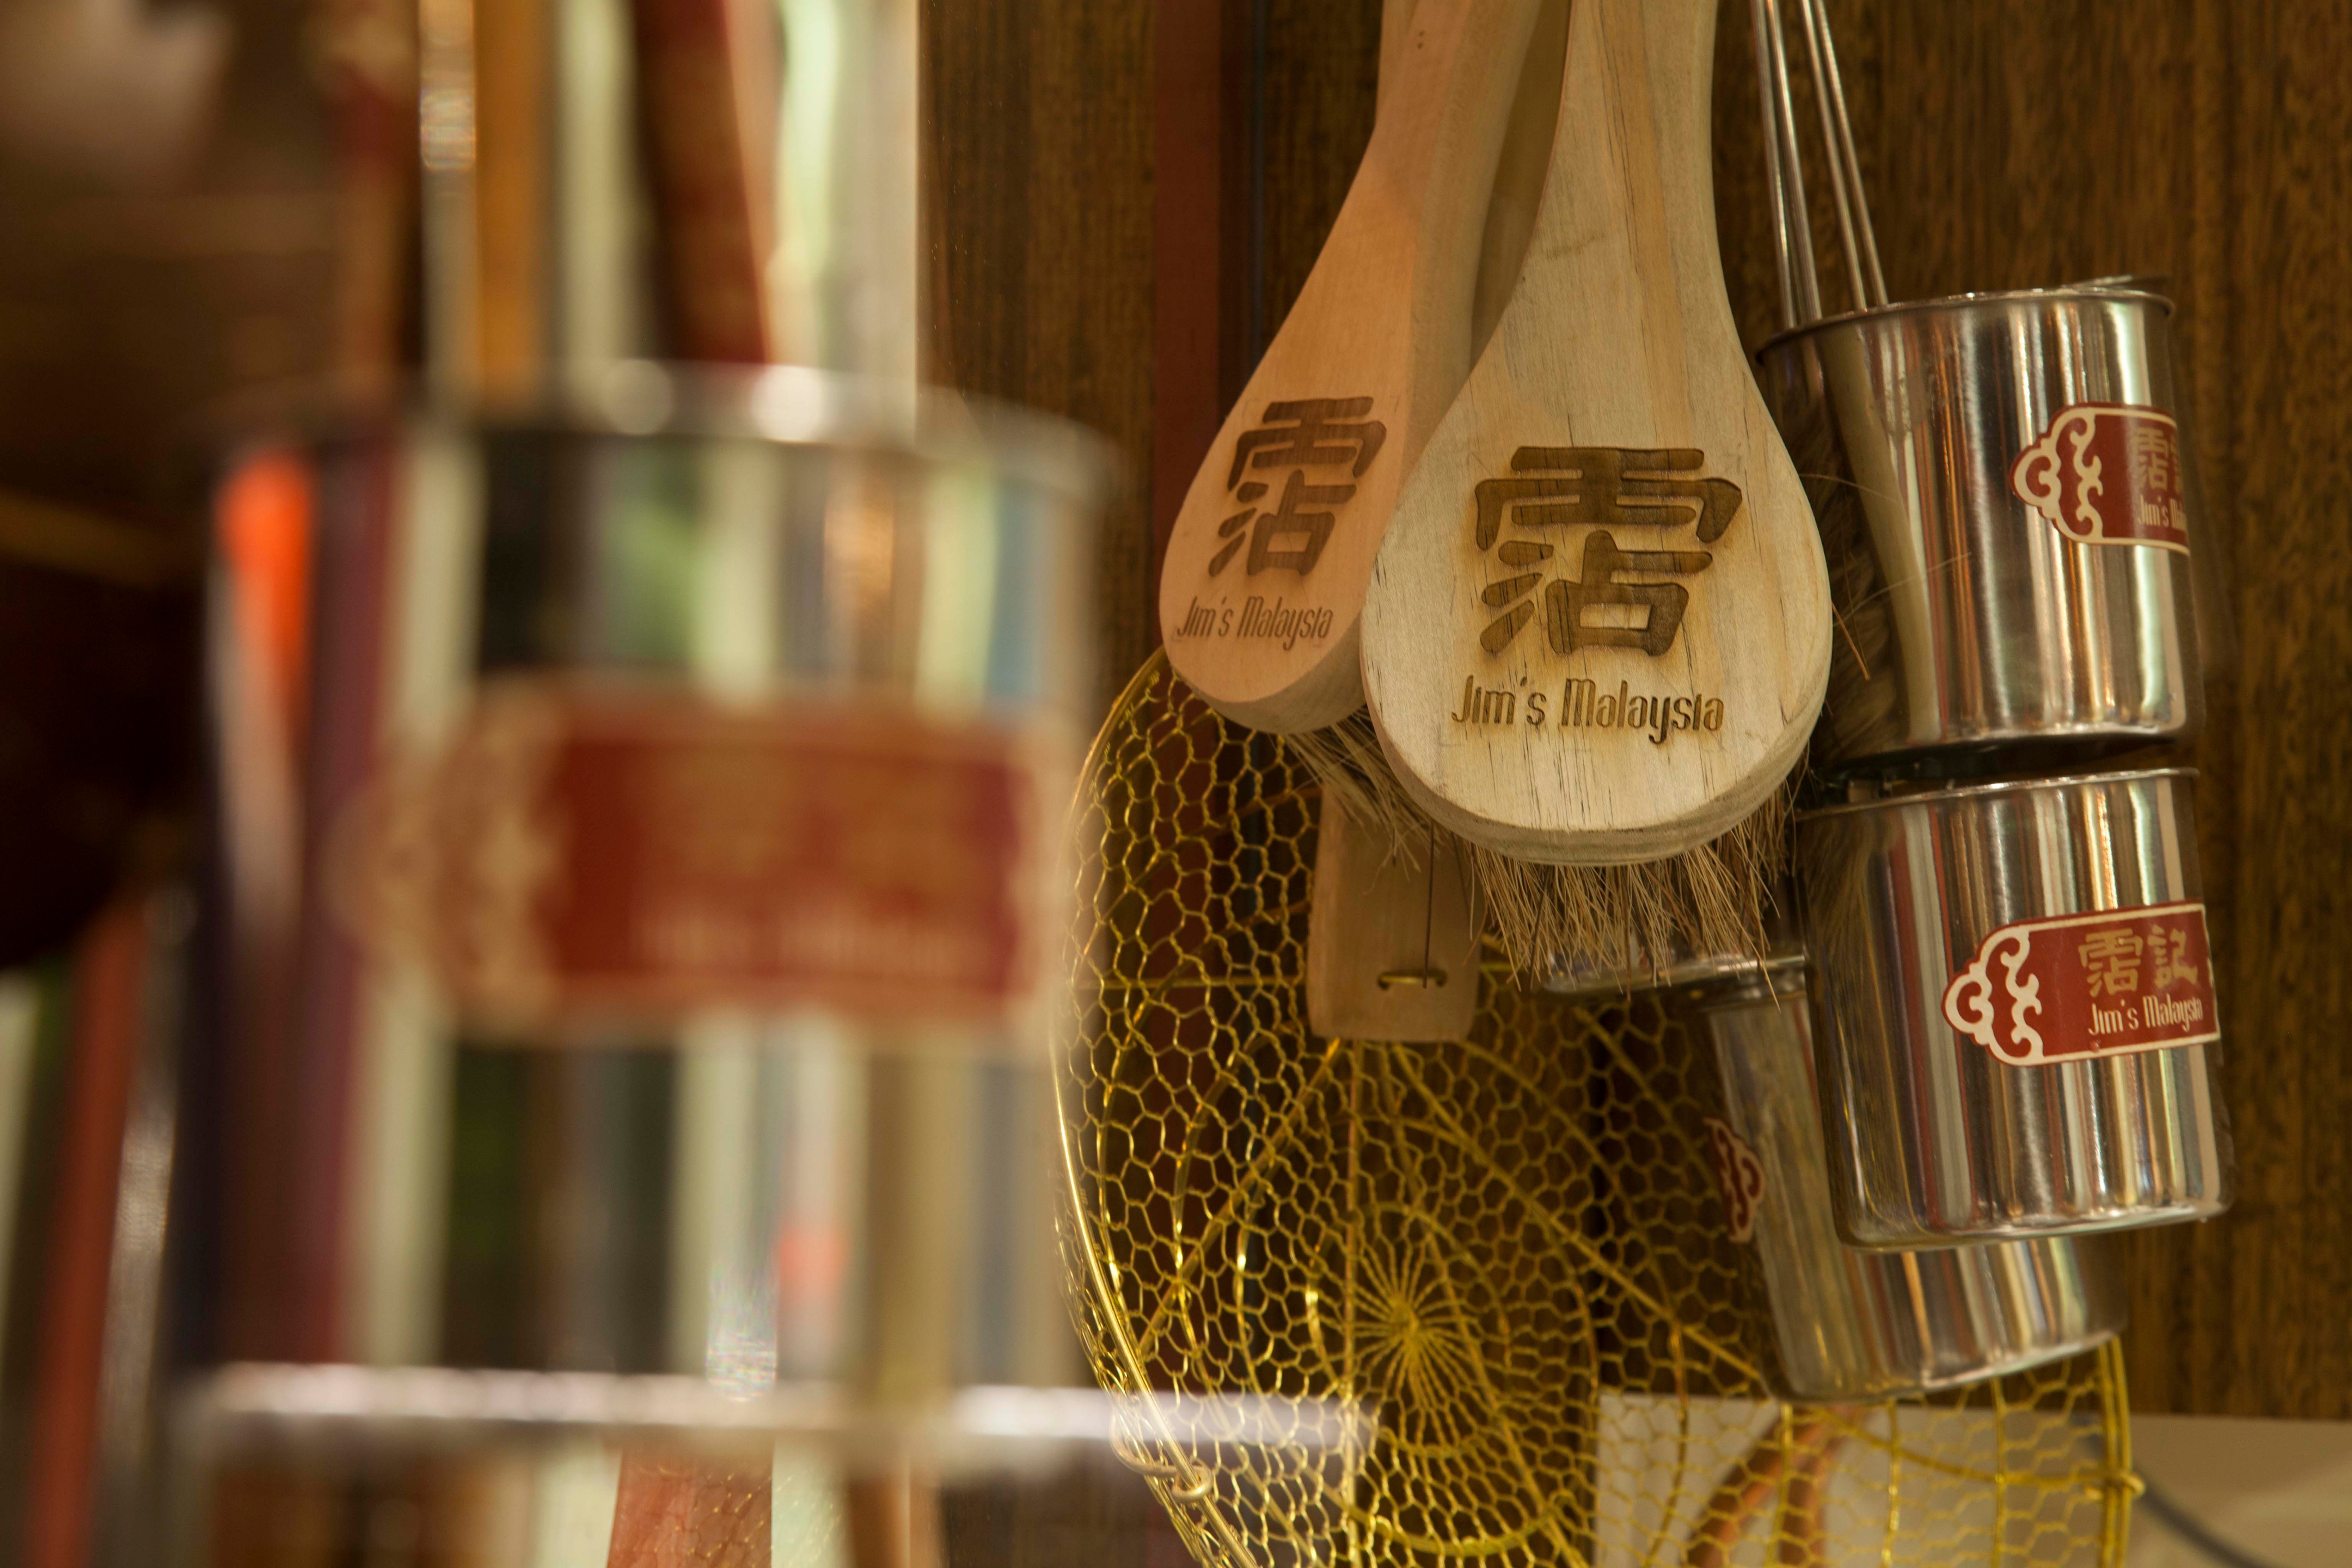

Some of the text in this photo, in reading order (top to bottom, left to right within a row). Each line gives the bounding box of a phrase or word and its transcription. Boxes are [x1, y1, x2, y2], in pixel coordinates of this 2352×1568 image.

[2137, 494, 2170, 528] Jim's
[1177, 595, 1334, 651] Jim's Malaysia
[1451, 674, 1724, 745] Jim's Malaysia
[2088, 993, 2204, 1036] Jim's Malaysia
